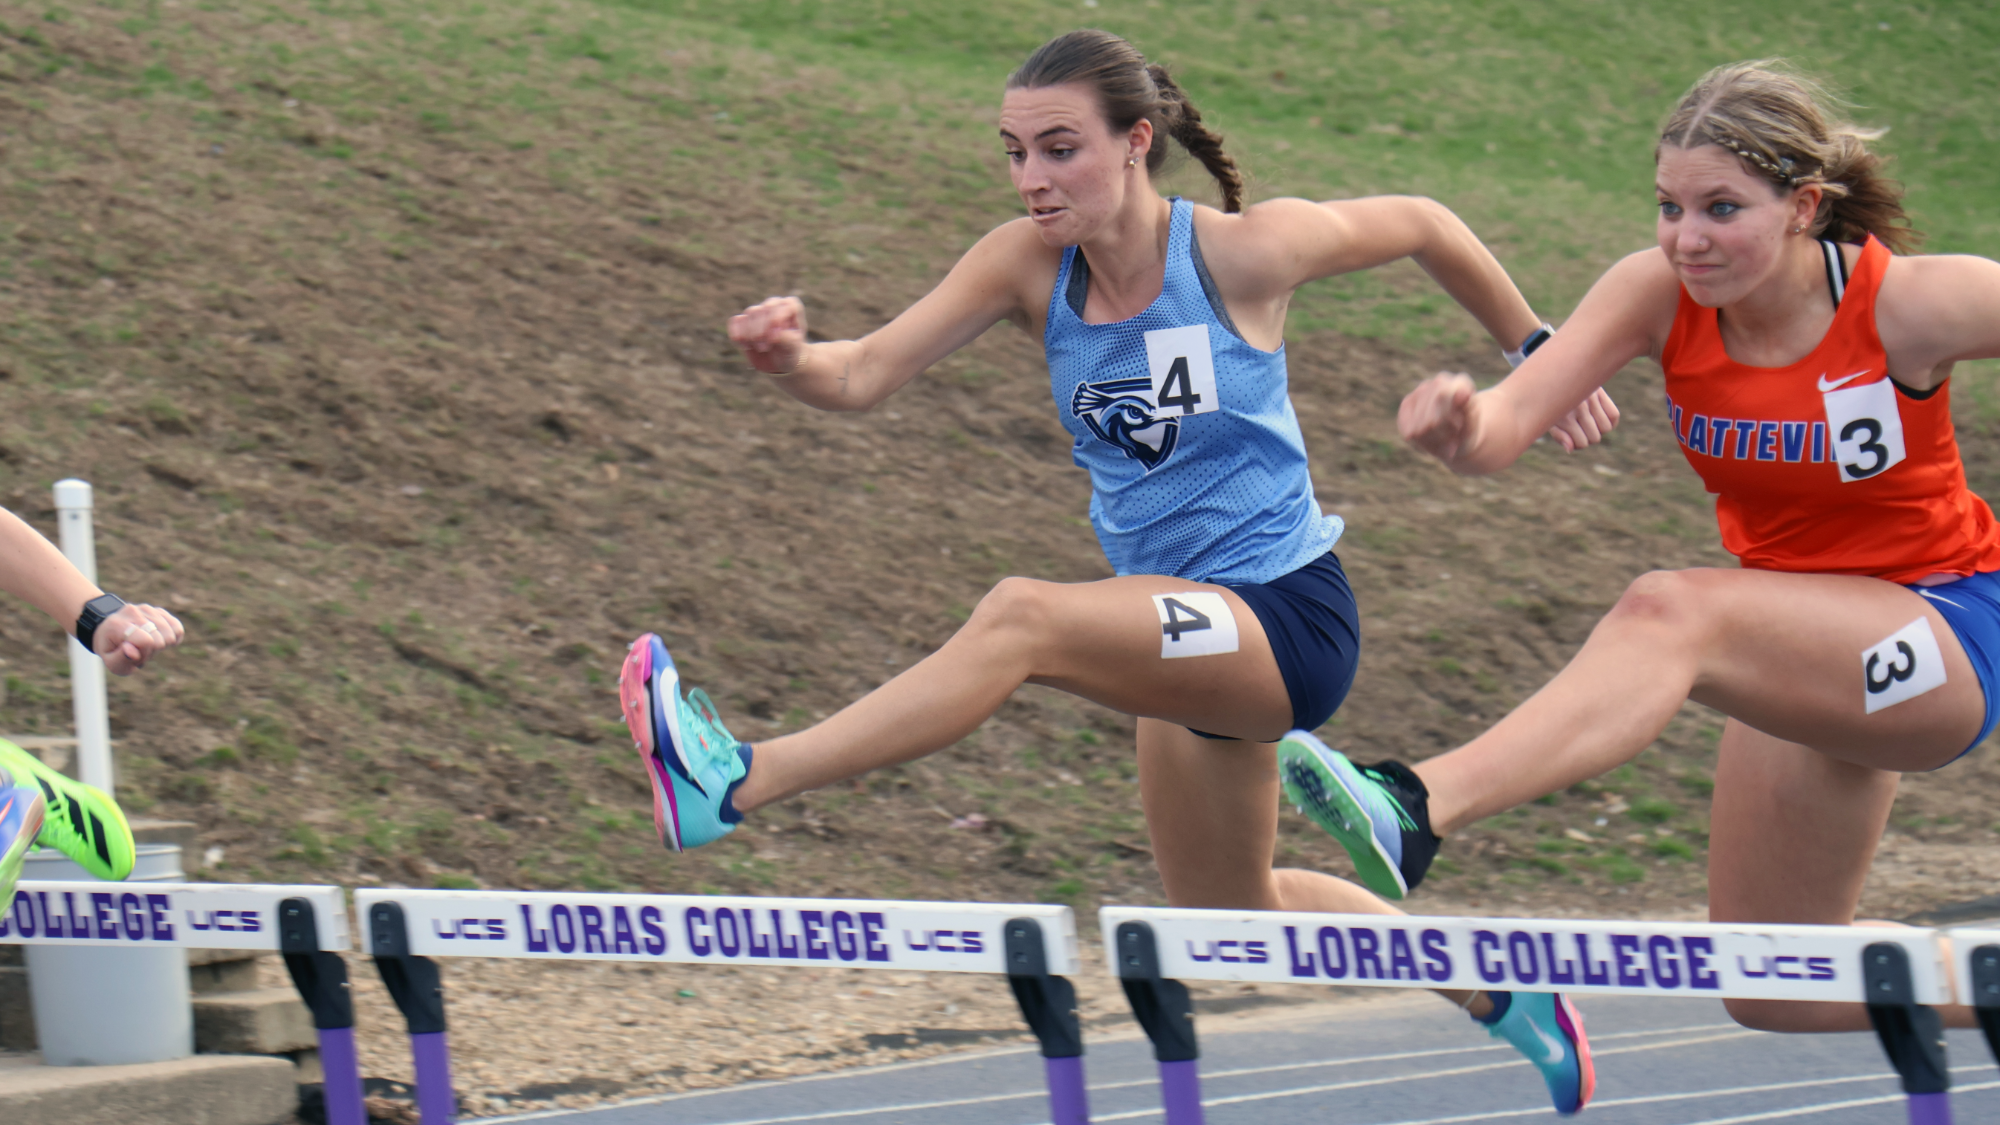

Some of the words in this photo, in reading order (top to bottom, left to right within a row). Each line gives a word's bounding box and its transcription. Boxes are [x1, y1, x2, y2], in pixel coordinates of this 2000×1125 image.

[1157, 356, 1202, 415] 4
[1666, 393, 1837, 463] LATTEVI
[1840, 418, 1889, 479] 3
[1161, 597, 1212, 642] 4
[1866, 640, 1916, 695] 3
[187, 910, 262, 932] UCS
[432, 917, 508, 940] UCS
[521, 903, 668, 956] LORAS
[684, 906, 890, 962] COLLEGE
[904, 929, 984, 954] UCS
[1185, 939, 1270, 964] UCS
[1282, 925, 1454, 982] LORAS
[1473, 929, 1721, 989] COLLEGE
[1737, 954, 1838, 981] UCS
